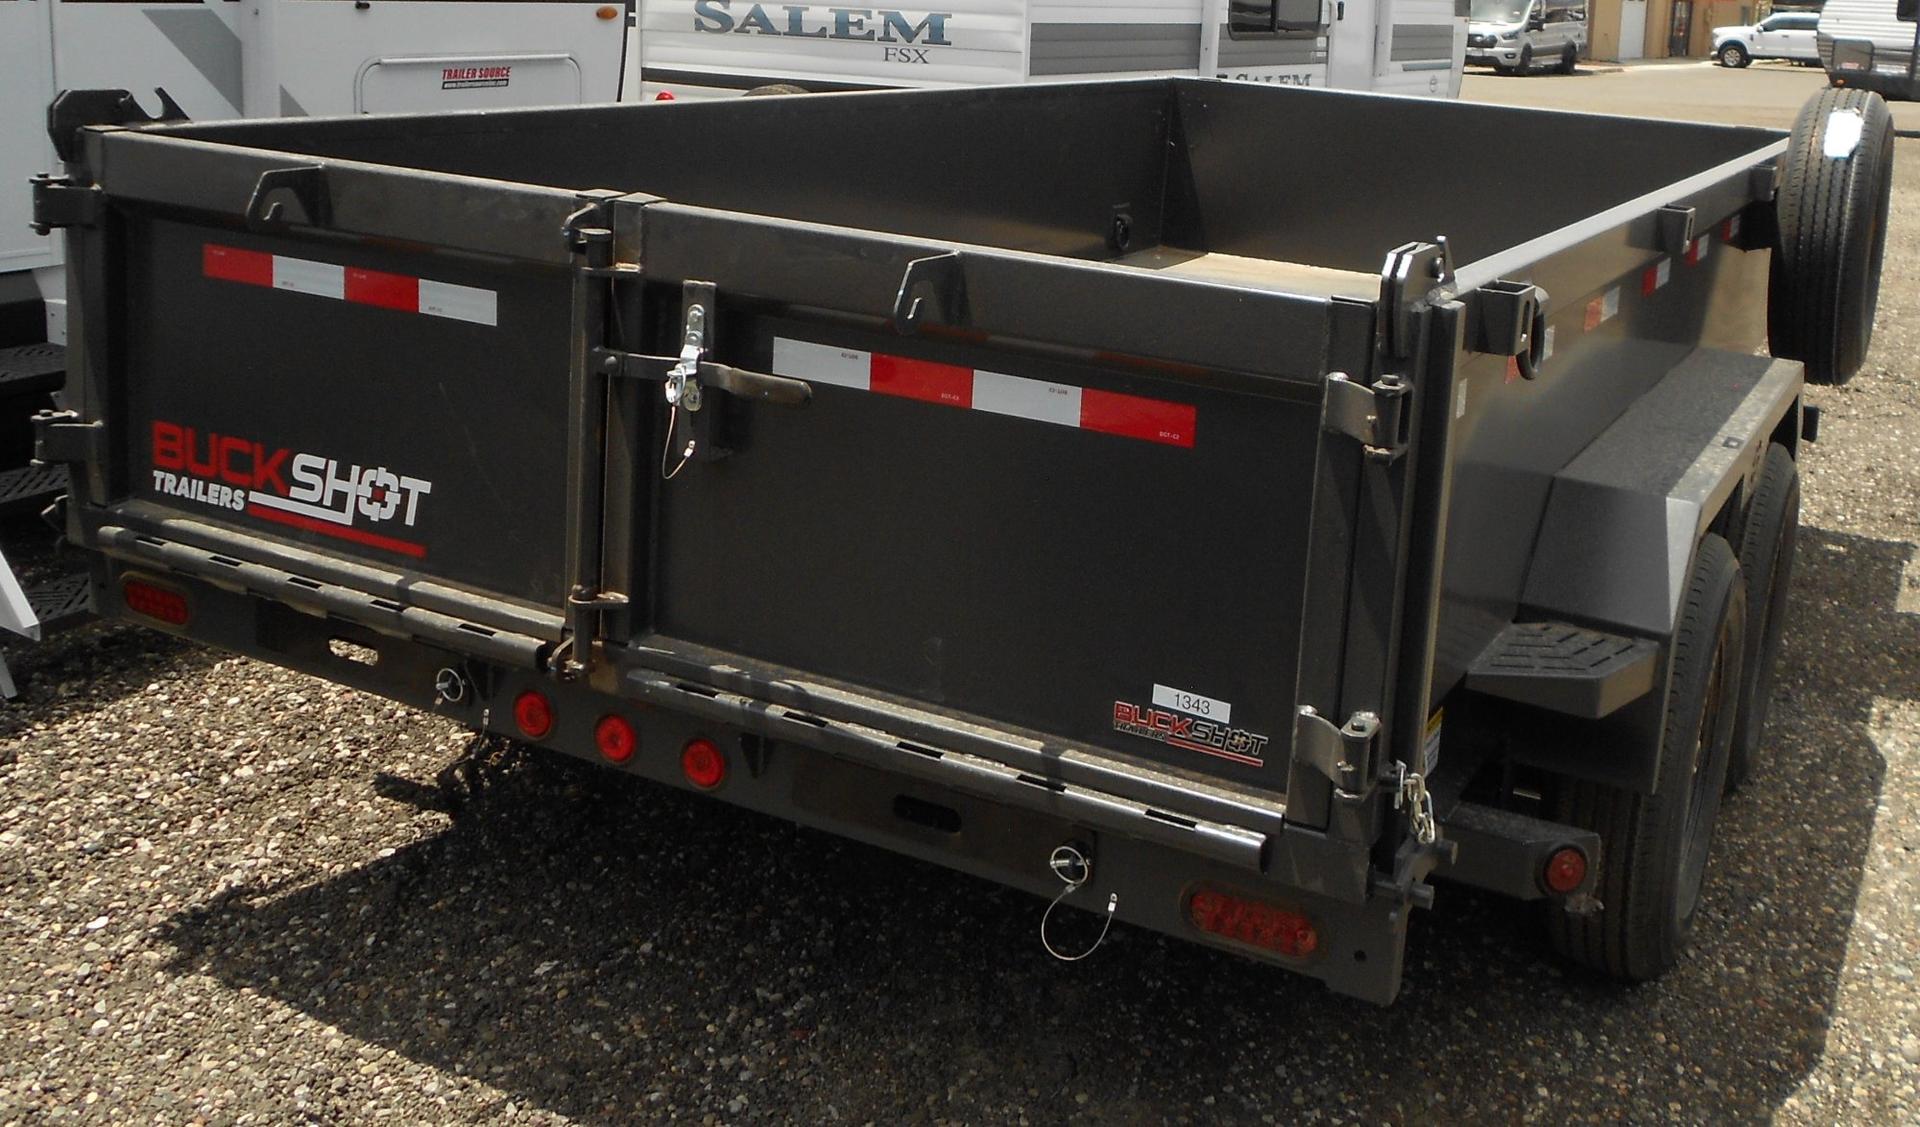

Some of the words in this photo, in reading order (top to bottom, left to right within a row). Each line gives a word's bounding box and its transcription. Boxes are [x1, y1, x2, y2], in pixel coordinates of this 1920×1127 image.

[694, 0, 952, 46] SALEM
[883, 47, 930, 64] FSX
[442, 68, 477, 80] TRAILER
[479, 66, 511, 78] SOURCE
[153, 470, 245, 512] TRAILERS
[1174, 693, 1211, 716] 1343
[1114, 700, 1268, 756] BUCKSHOT
